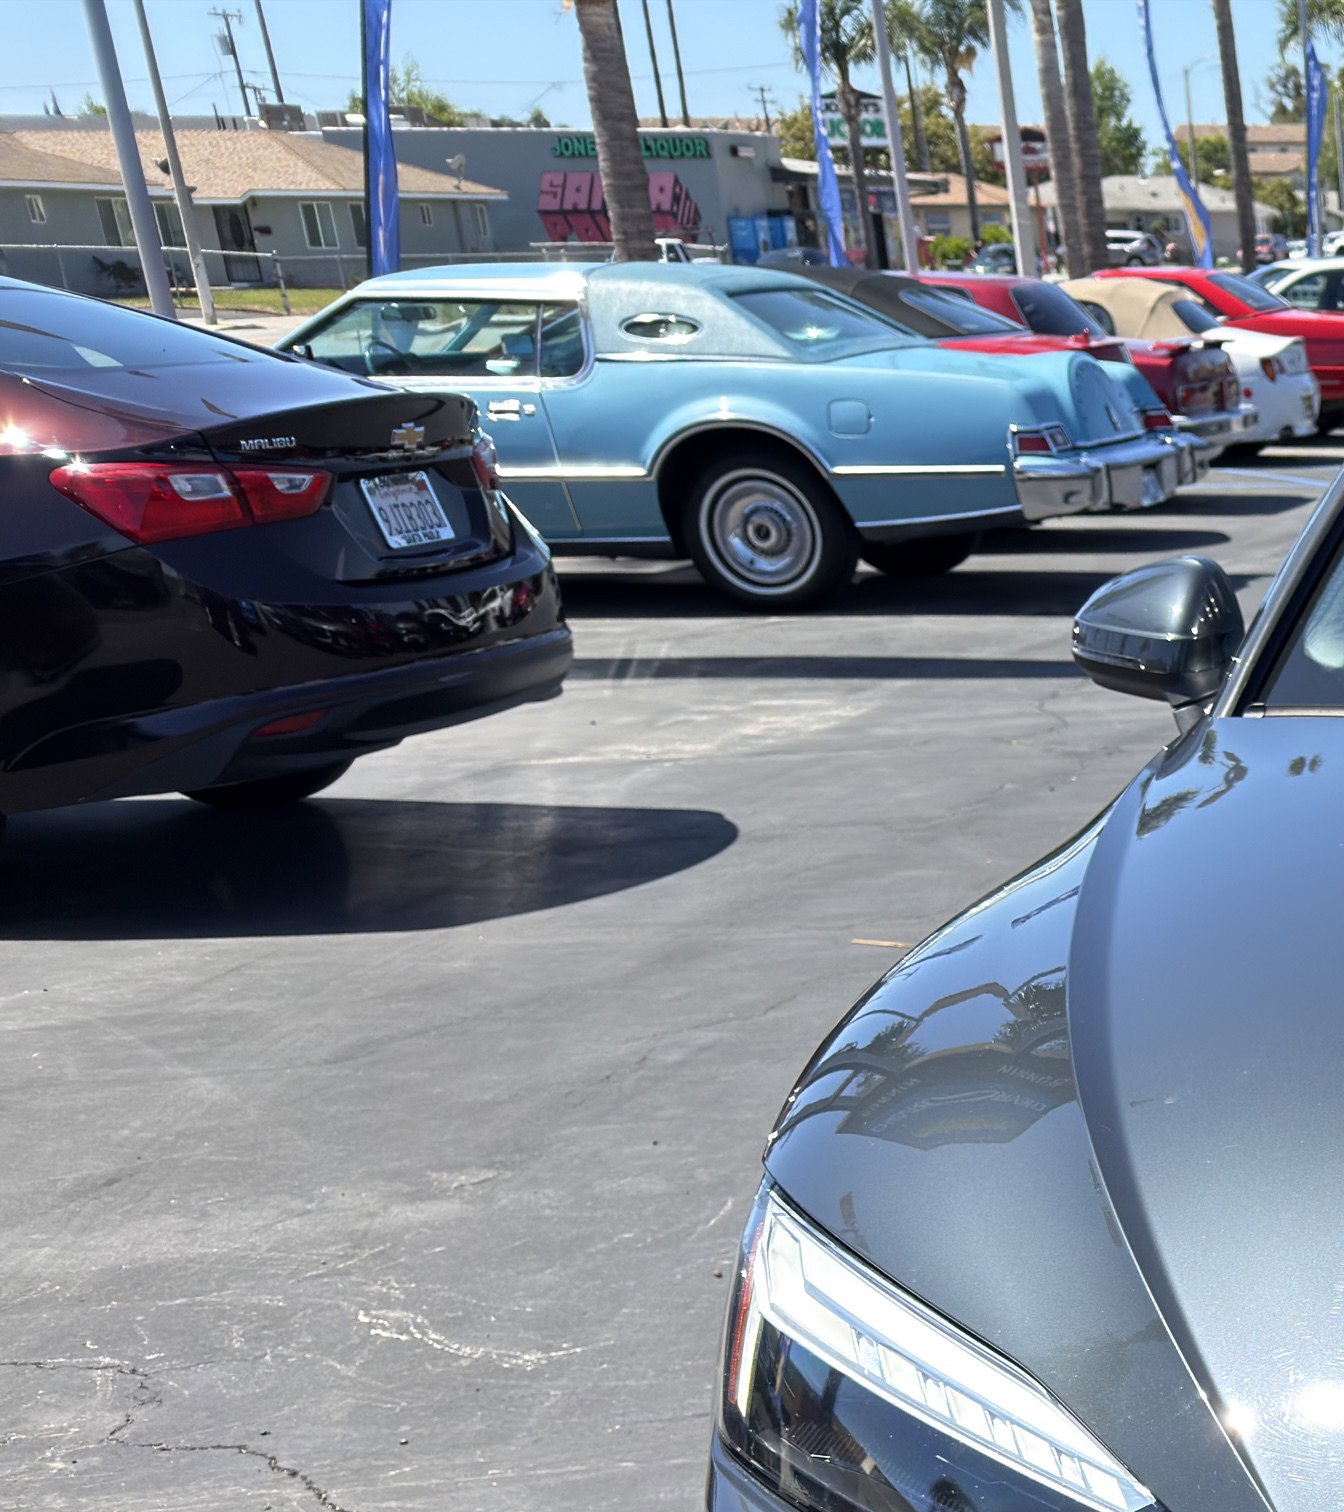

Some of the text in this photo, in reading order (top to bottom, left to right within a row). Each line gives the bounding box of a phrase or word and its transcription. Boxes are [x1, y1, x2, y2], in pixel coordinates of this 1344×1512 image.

[552, 137, 710, 159] JONE LIQUOR
[240, 436, 296, 450] MALIBU
